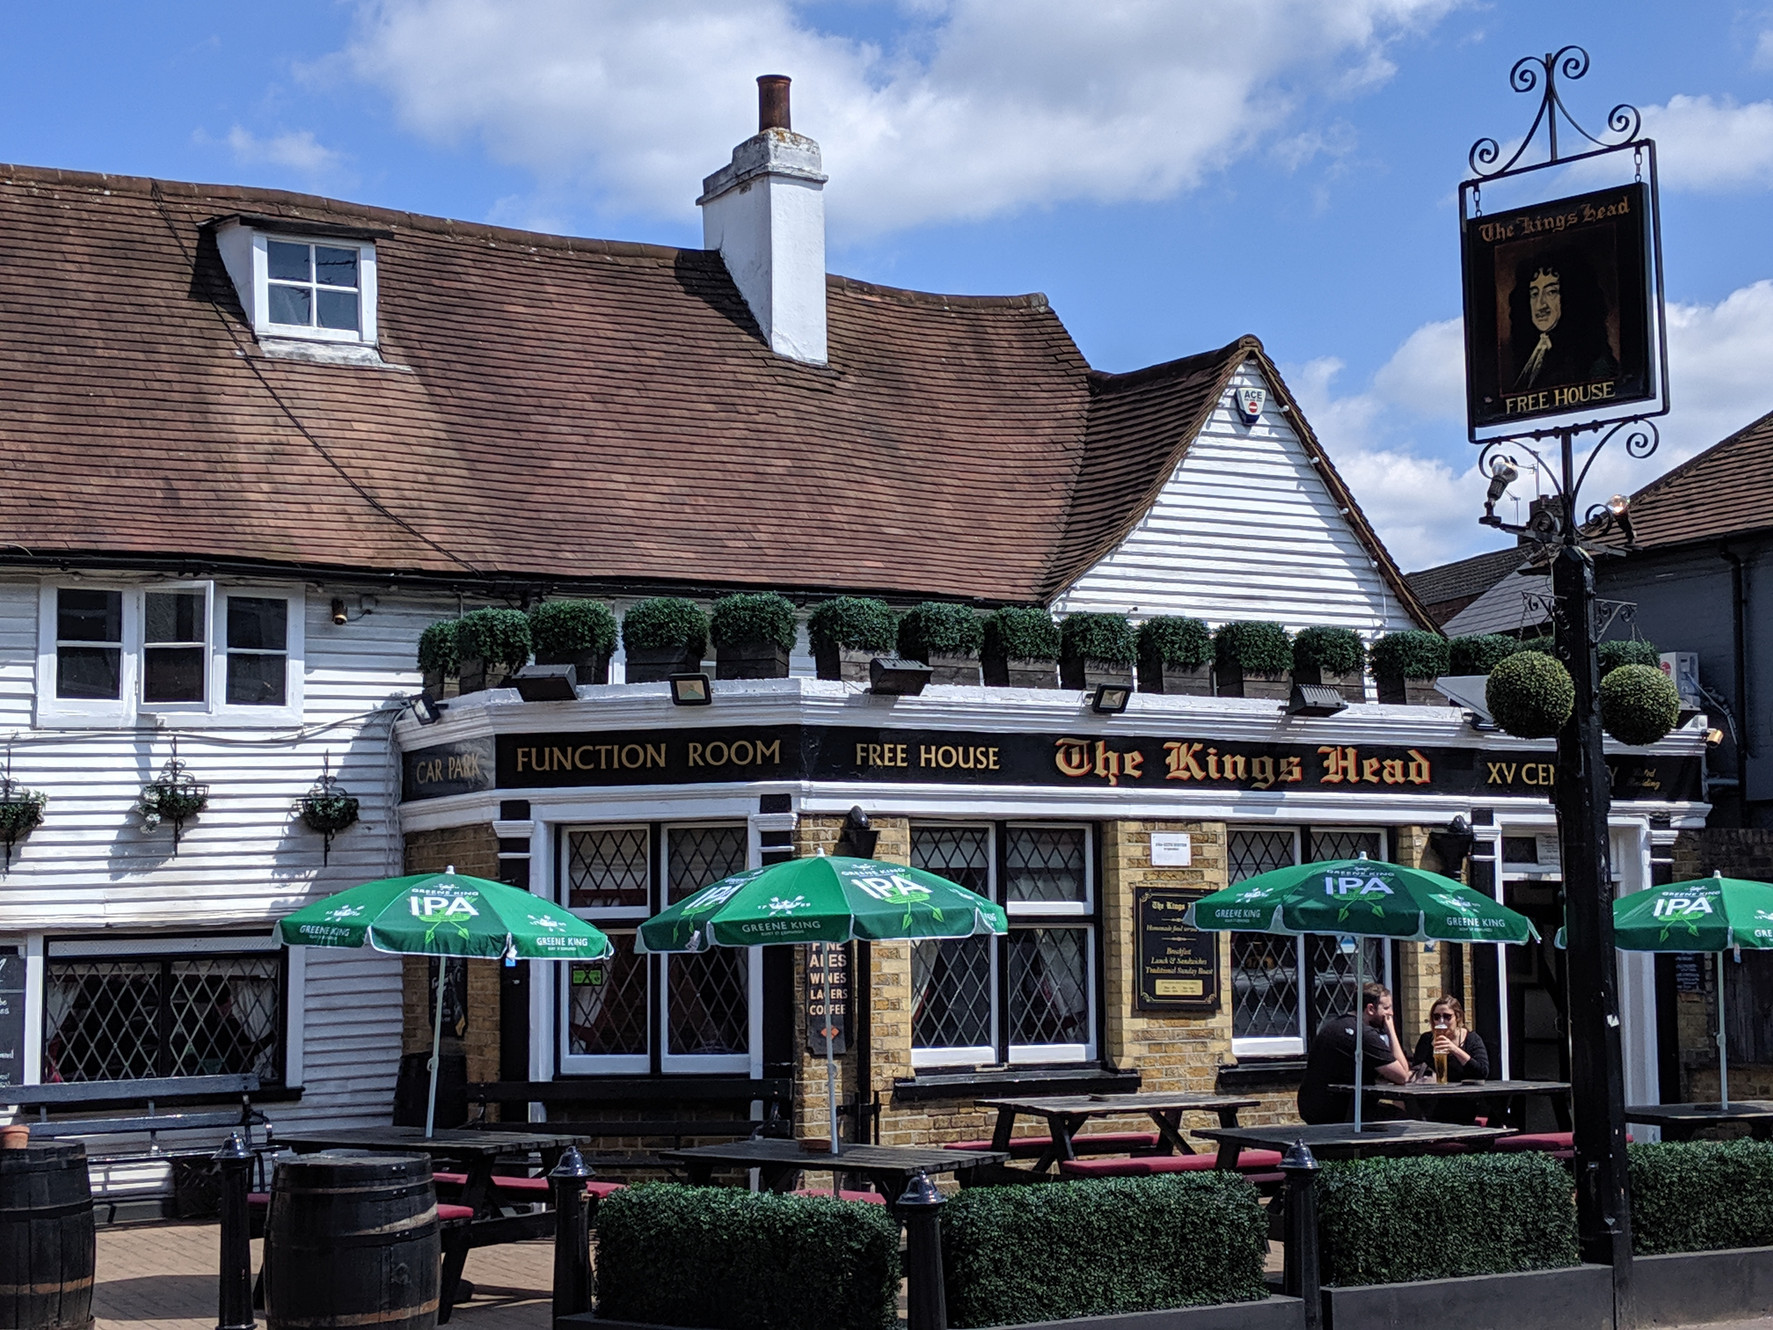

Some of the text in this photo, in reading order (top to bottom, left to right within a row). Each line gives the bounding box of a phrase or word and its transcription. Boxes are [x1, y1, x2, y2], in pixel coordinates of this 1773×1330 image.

[1479, 196, 1631, 242] The Kings Head
[1244, 390, 1262, 399] ACE
[1505, 381, 1616, 414] FREE HOUSE
[517, 739, 781, 772] FUNCTION ROOM
[855, 743, 1000, 770] FREE HOUSE
[1054, 737, 1431, 790] The Kings Head
[416, 753, 481, 784] CAR PARK
[1487, 762, 1517, 785] XV
[684, 883, 746, 910] IPA
[851, 875, 933, 899] IPA
[1325, 877, 1395, 895] IPA
[410, 895, 480, 916] IPA
[1243, 909, 1261, 918] KING
[1653, 896, 1713, 917] IPA
[299, 925, 351, 937] GREENE KING
[741, 920, 822, 933] GREENE KING
[1446, 917, 1506, 928] GREENE KING
[536, 937, 588, 947] GREENE KING
[812, 942, 845, 951] FNE
[810, 989, 848, 1000] LAERS
